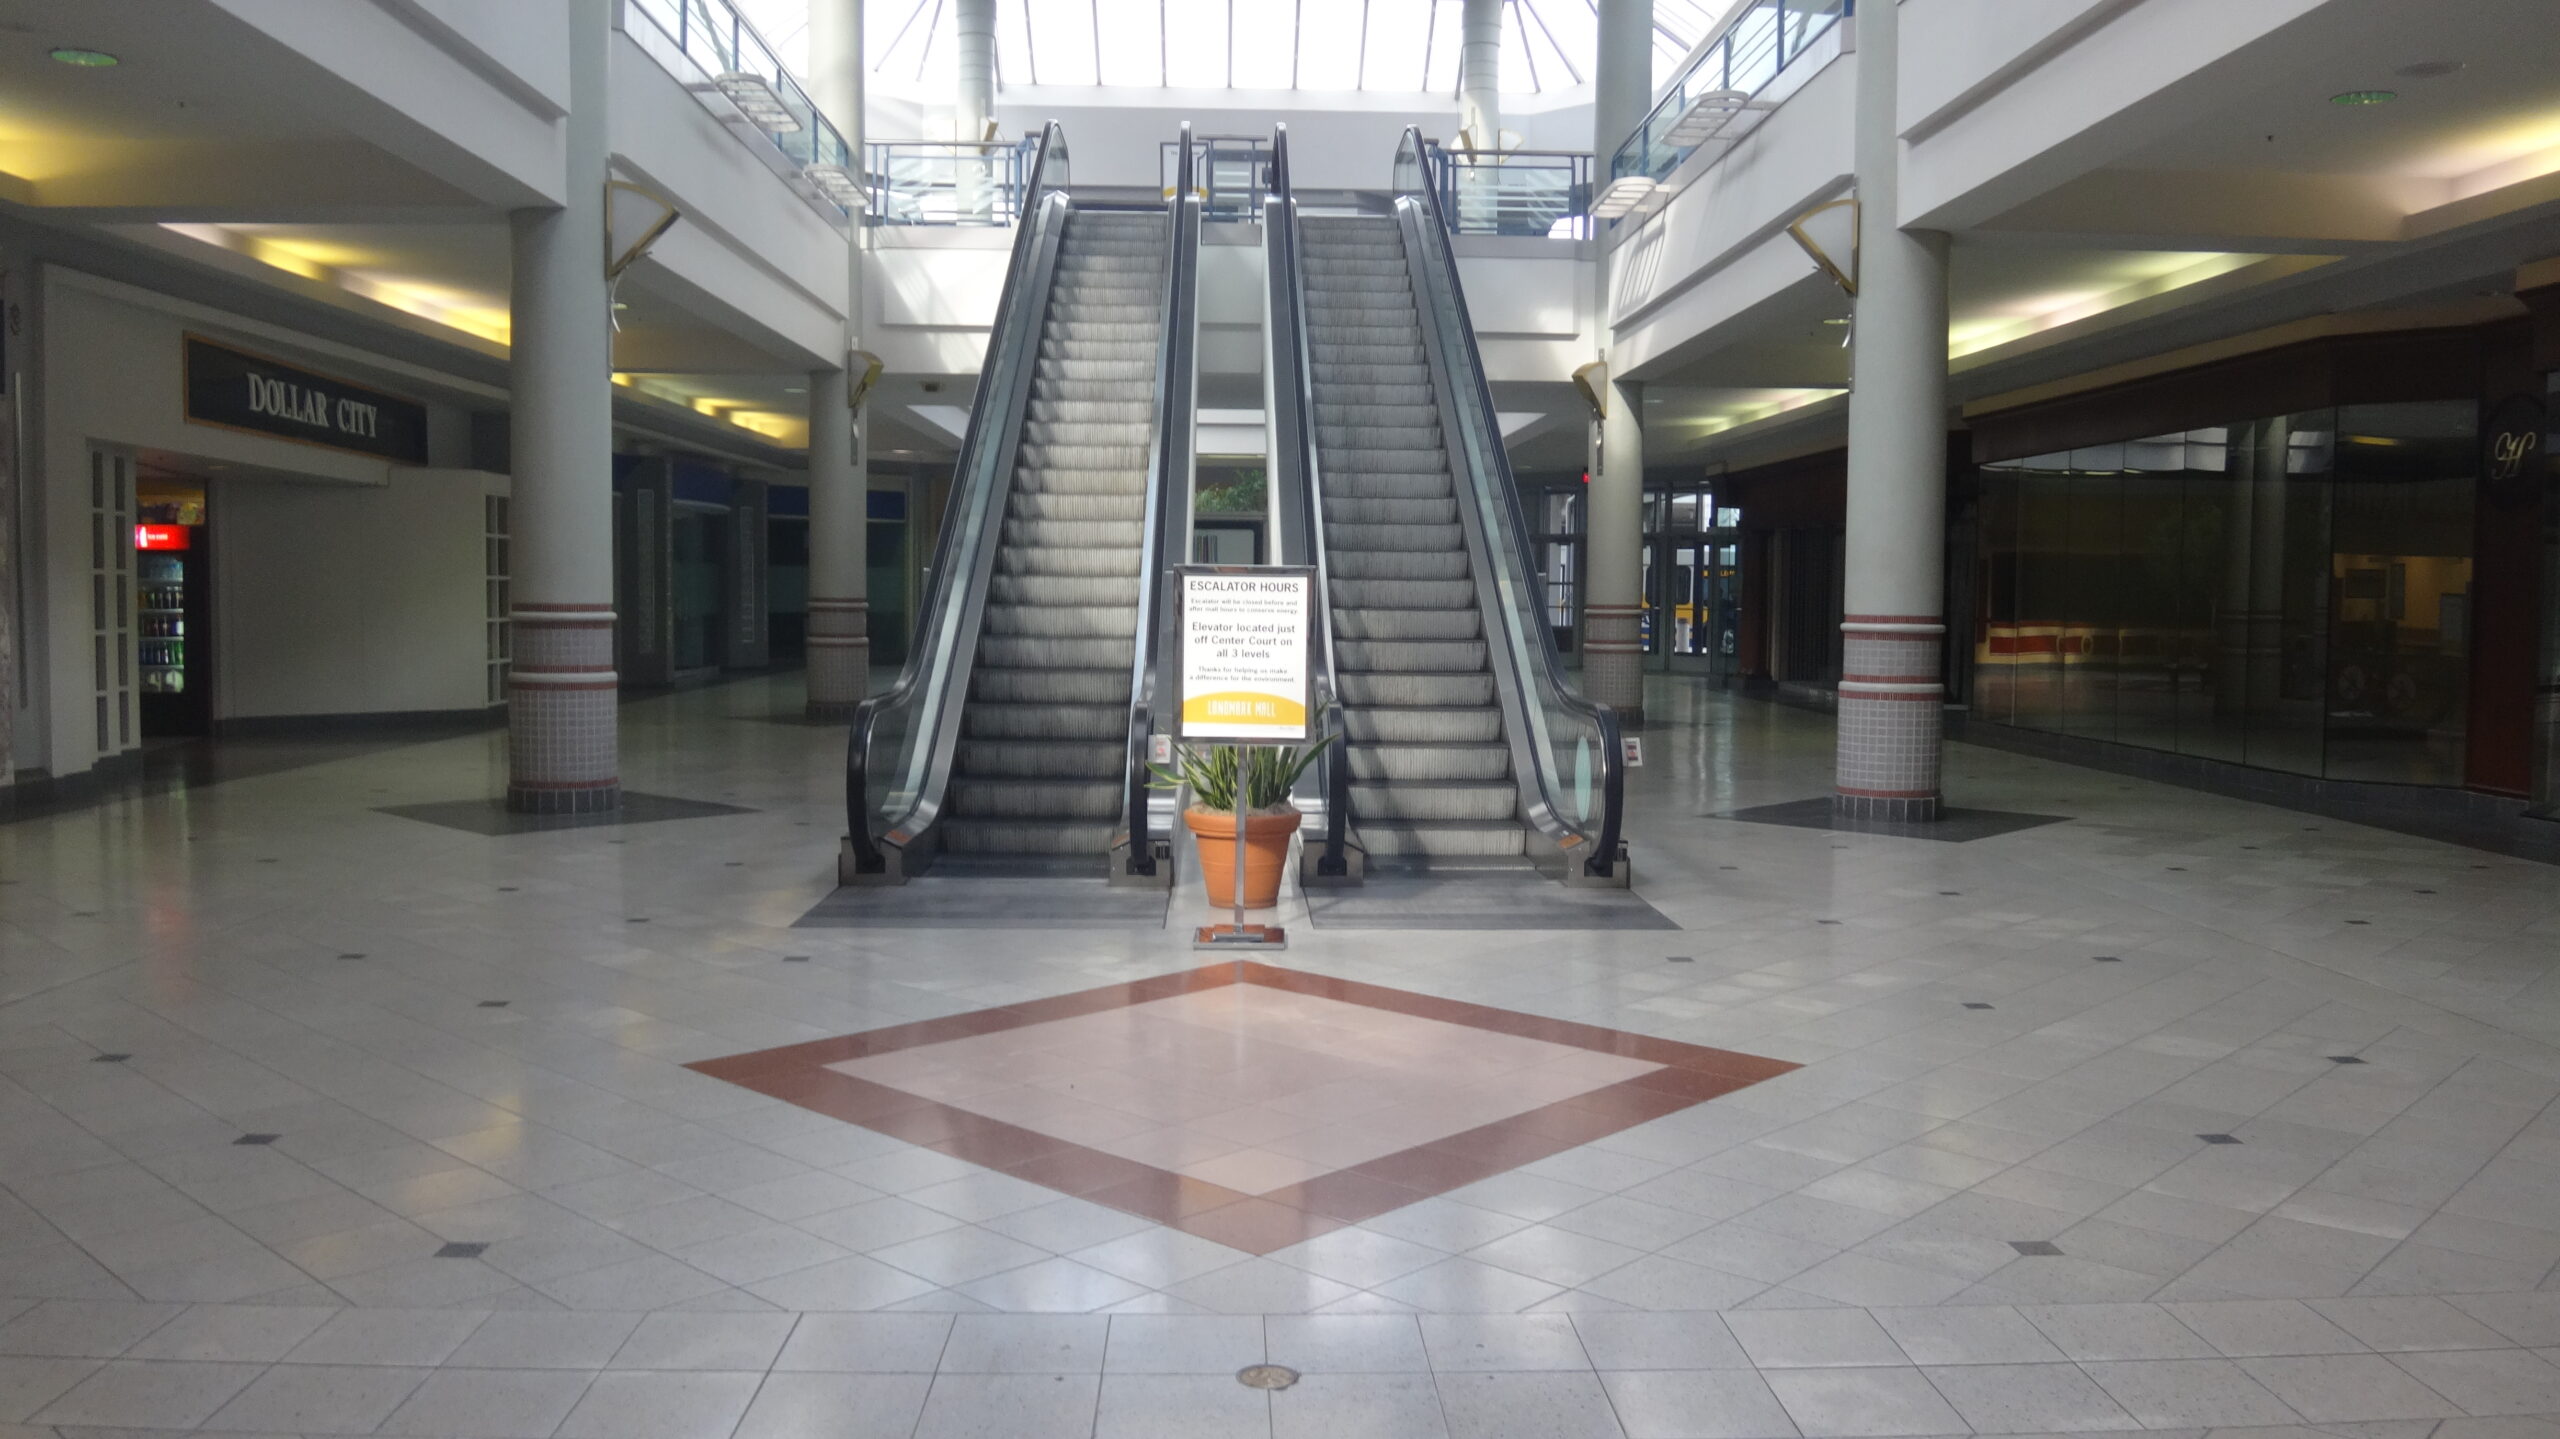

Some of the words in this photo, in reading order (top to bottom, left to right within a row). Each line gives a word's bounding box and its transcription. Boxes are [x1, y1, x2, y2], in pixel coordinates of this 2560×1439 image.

[247, 372, 329, 428] DOLLAR
[336, 397, 377, 438] CITY
[1190, 581, 1256, 592] ESCALATOR
[1260, 582, 1298, 593] HOURS
[1192, 622, 1233, 632] Elevator
[1237, 623, 1274, 633] located
[1277, 625, 1295, 635] just
[1195, 635, 1208, 645] off
[1212, 635, 1244, 645] Center
[1249, 636, 1276, 646] Court
[1242, 649, 1270, 659] levels
[1235, 667, 1257, 675] helping
[1256, 701, 1276, 718] MALL
